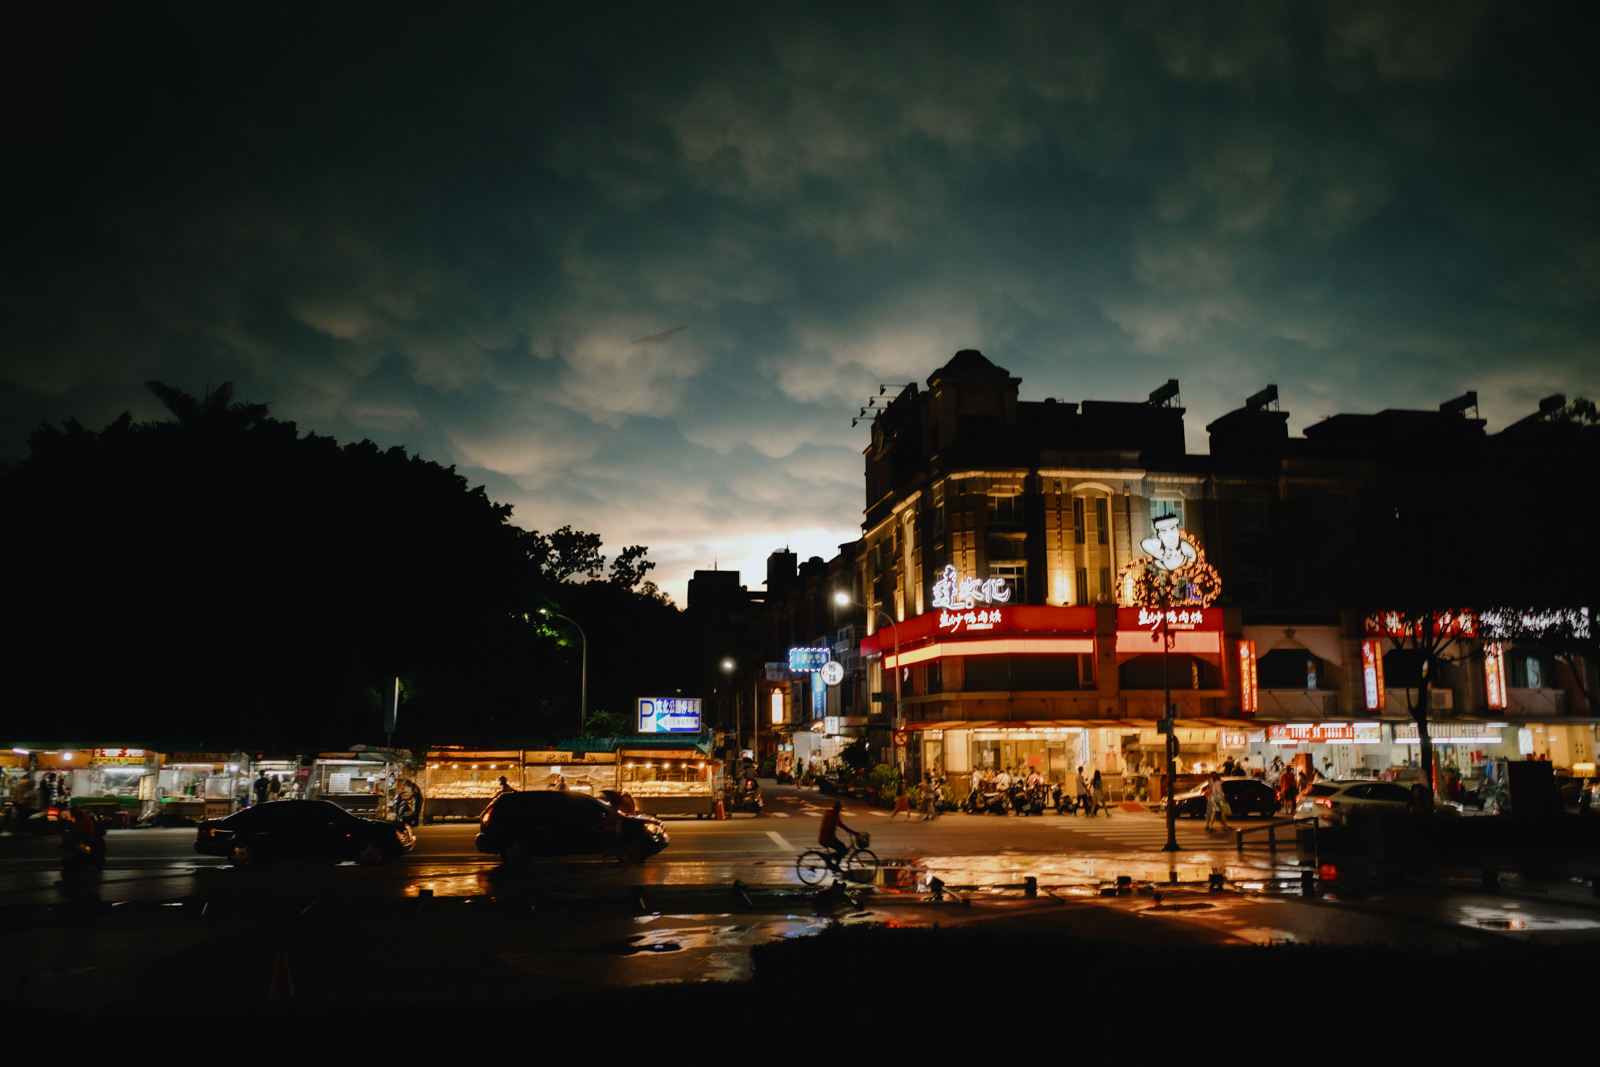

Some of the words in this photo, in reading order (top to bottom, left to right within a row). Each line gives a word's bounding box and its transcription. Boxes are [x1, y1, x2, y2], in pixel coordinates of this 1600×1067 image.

[640, 700, 655, 729] P
[656, 699, 699, 714] 文化公園停車場
